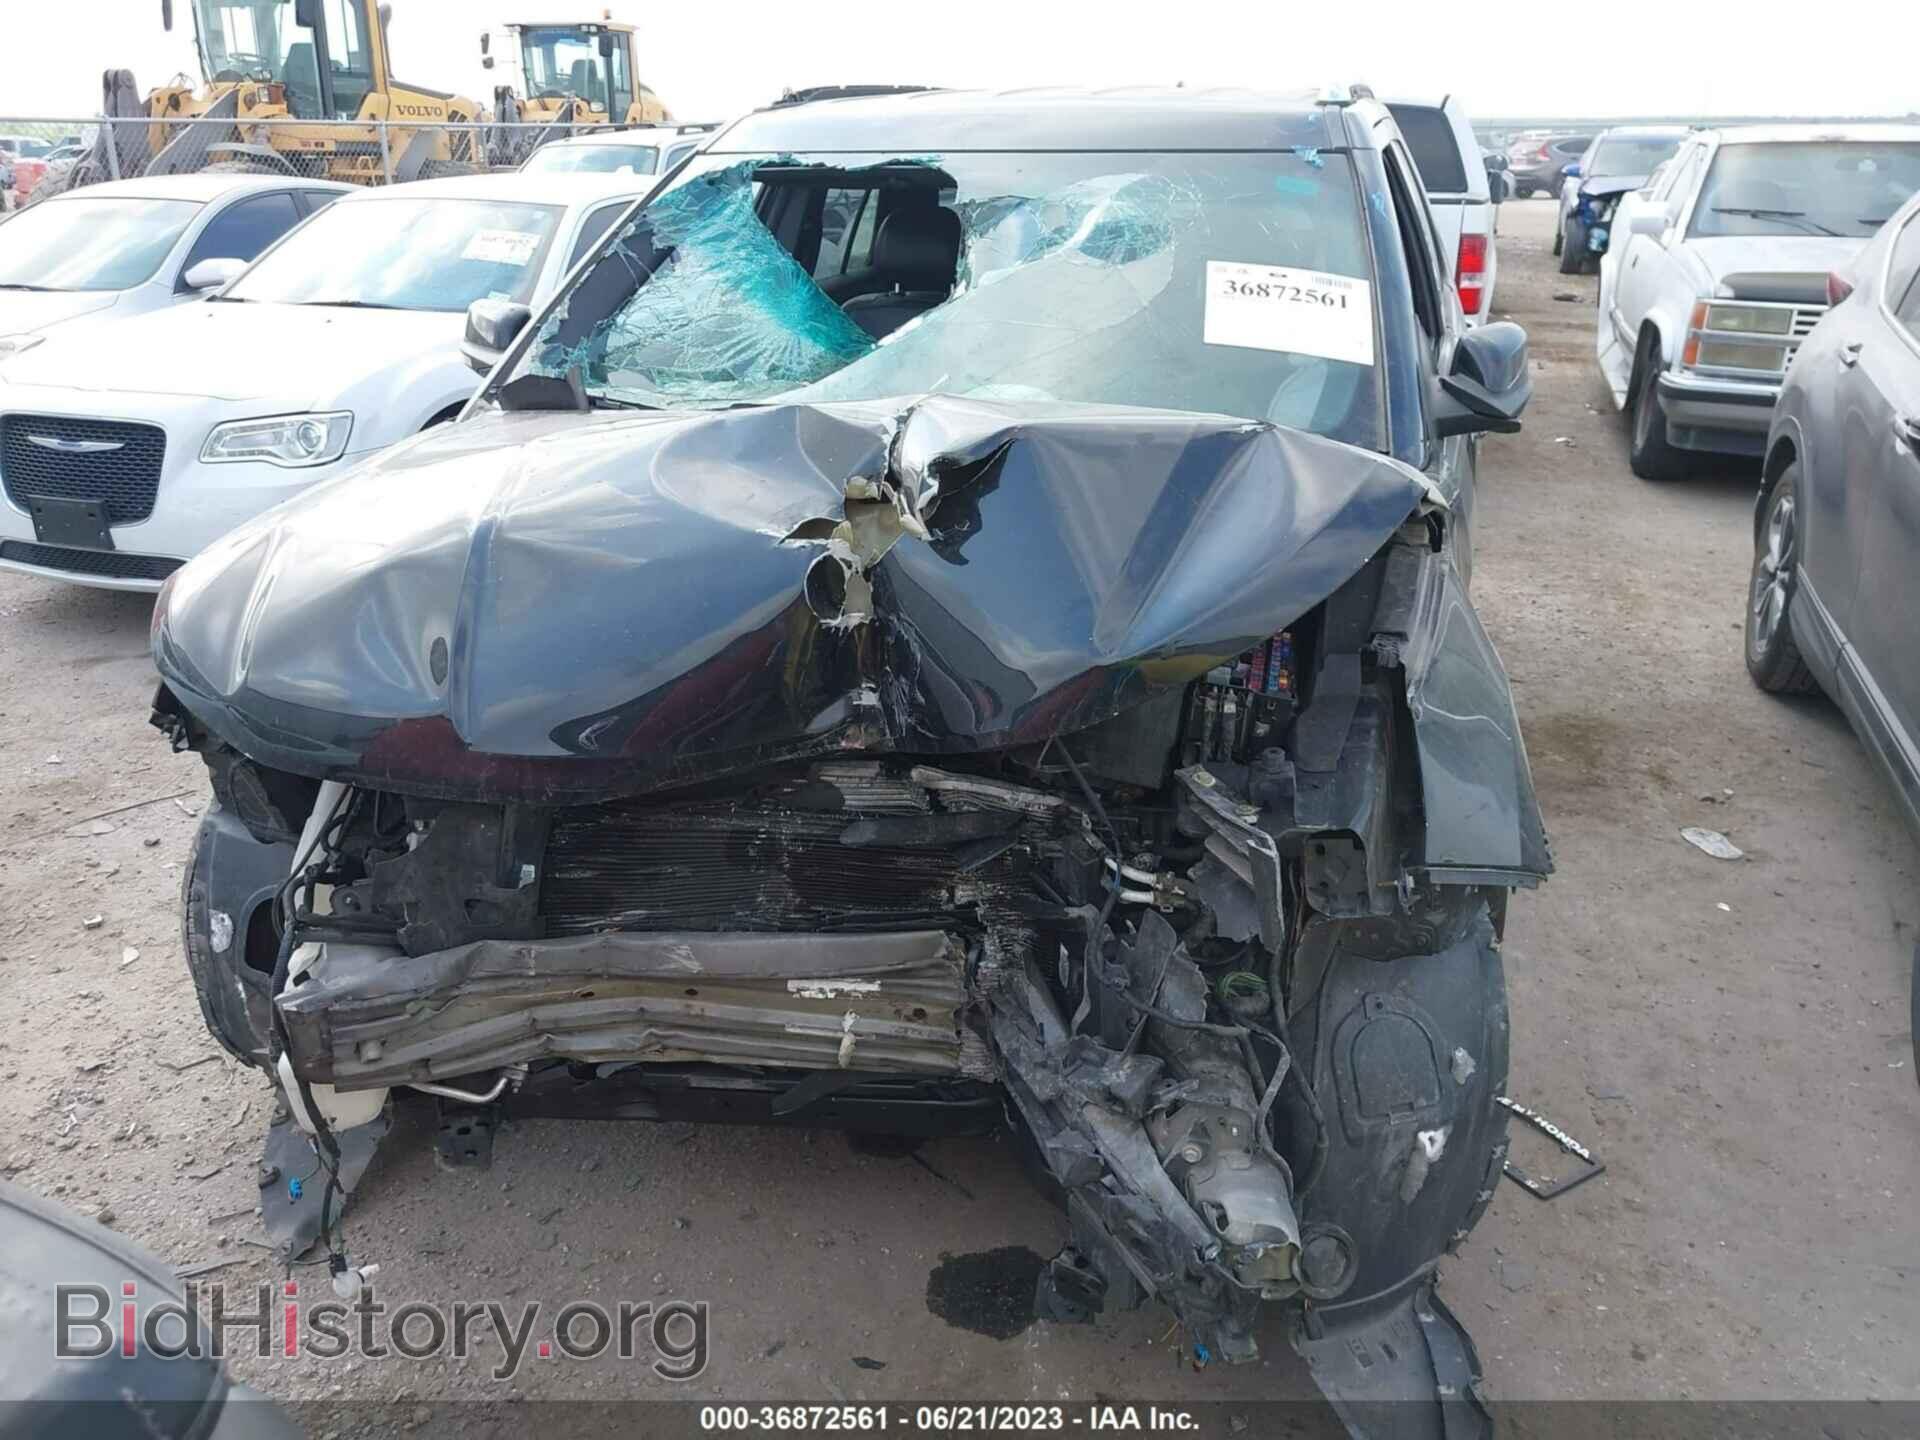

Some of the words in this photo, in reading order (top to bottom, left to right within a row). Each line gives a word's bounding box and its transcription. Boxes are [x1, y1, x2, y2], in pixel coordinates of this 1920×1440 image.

[395, 104, 443, 117] VOLVO
[1223, 279, 1348, 309] 36872561
[1533, 1116, 1590, 1158] HONDA
